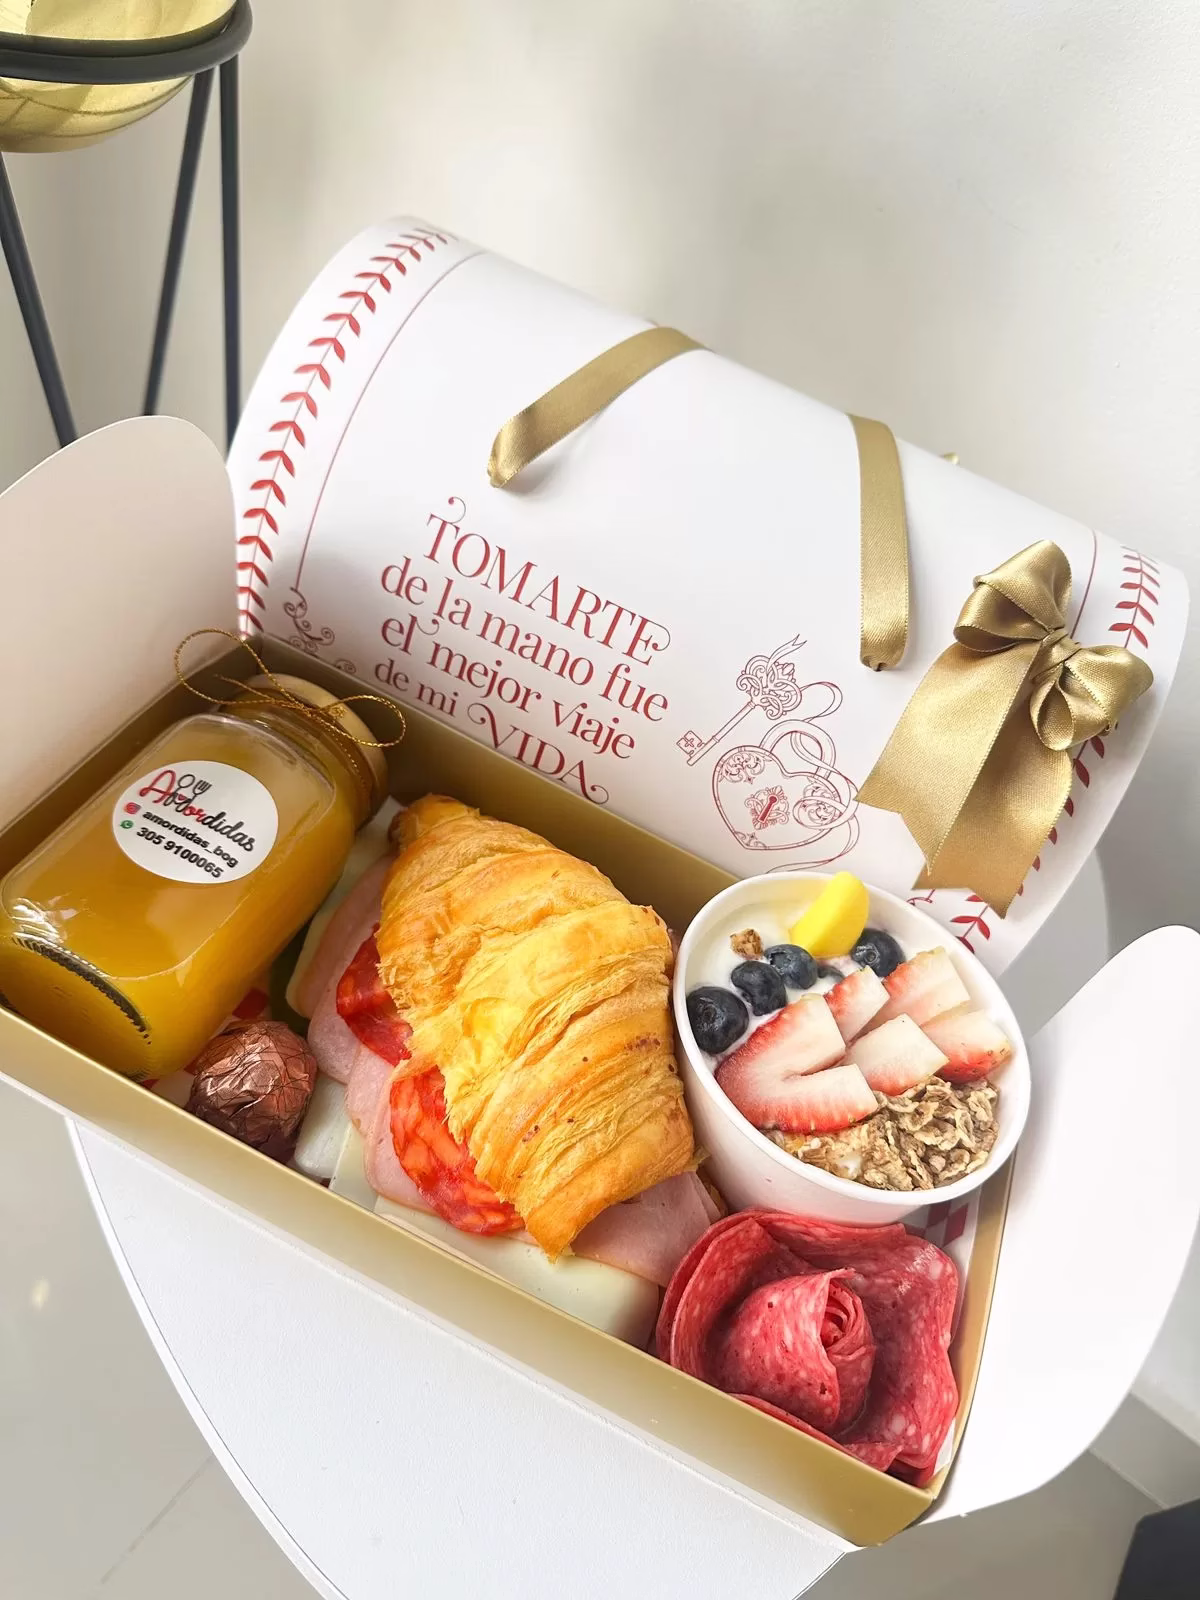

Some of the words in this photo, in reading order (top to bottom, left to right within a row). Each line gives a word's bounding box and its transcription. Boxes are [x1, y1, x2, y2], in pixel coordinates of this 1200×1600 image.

[380, 555, 428, 606] de
[433, 576, 470, 631] la
[476, 610, 595, 686] mano
[598, 662, 668, 722] fue
[424, 496, 671, 666] TOMARTE
[374, 658, 410, 692] de
[417, 681, 459, 718] mi
[467, 702, 610, 805] VIDA
[380, 613, 440, 656] el
[426, 640, 542, 713] mejor
[552, 699, 636, 760] viaje
[136, 826, 166, 846] 305
[163, 839, 224, 879] 9100065
[142, 810, 239, 869] amordidas_bog
